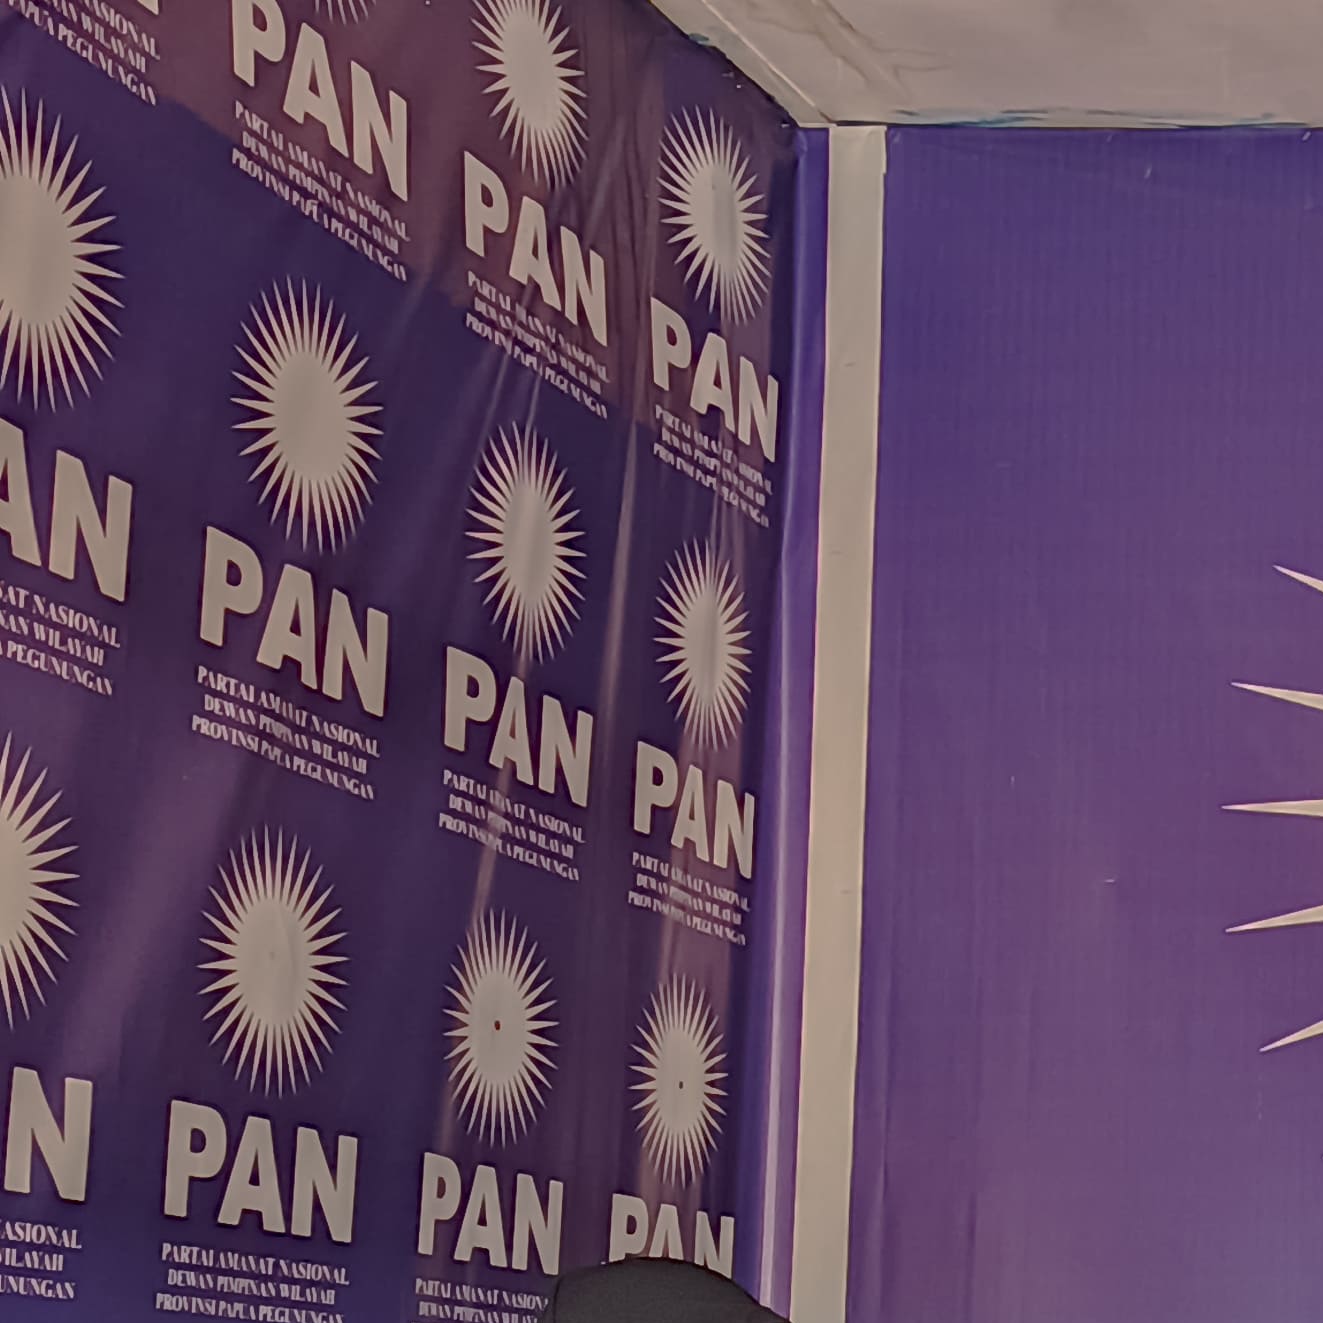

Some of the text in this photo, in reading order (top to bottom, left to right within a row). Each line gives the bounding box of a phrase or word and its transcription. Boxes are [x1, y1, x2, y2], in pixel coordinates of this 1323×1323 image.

[231, 0, 408, 201] PAN
[464, 151, 607, 347] PAN
[650, 296, 778, 462] PAN
[0, 416, 132, 602] AN
[7, 641, 112, 695] PEGUNUNGAN
[32, 594, 120, 648] NASIONAL
[33, 622, 104, 666] WILAYAH
[199, 525, 389, 717] PAN
[444, 646, 593, 808] PAN
[634, 741, 755, 879] PAN
[163, 1099, 358, 1243] PAN
[418, 1152, 563, 1275] PAN
[0, 1221, 82, 1249] ASIONAL
[161, 1243, 349, 1285] PARTAI AMANAT NASIONAL
[168, 1269, 335, 1305] DEWAN PIMPINAN WILAYAH
[609, 1193, 735, 1280] PAN
[156, 1293, 215, 1315] PROVINSI
[219, 1301, 256, 1320] PAPUA
